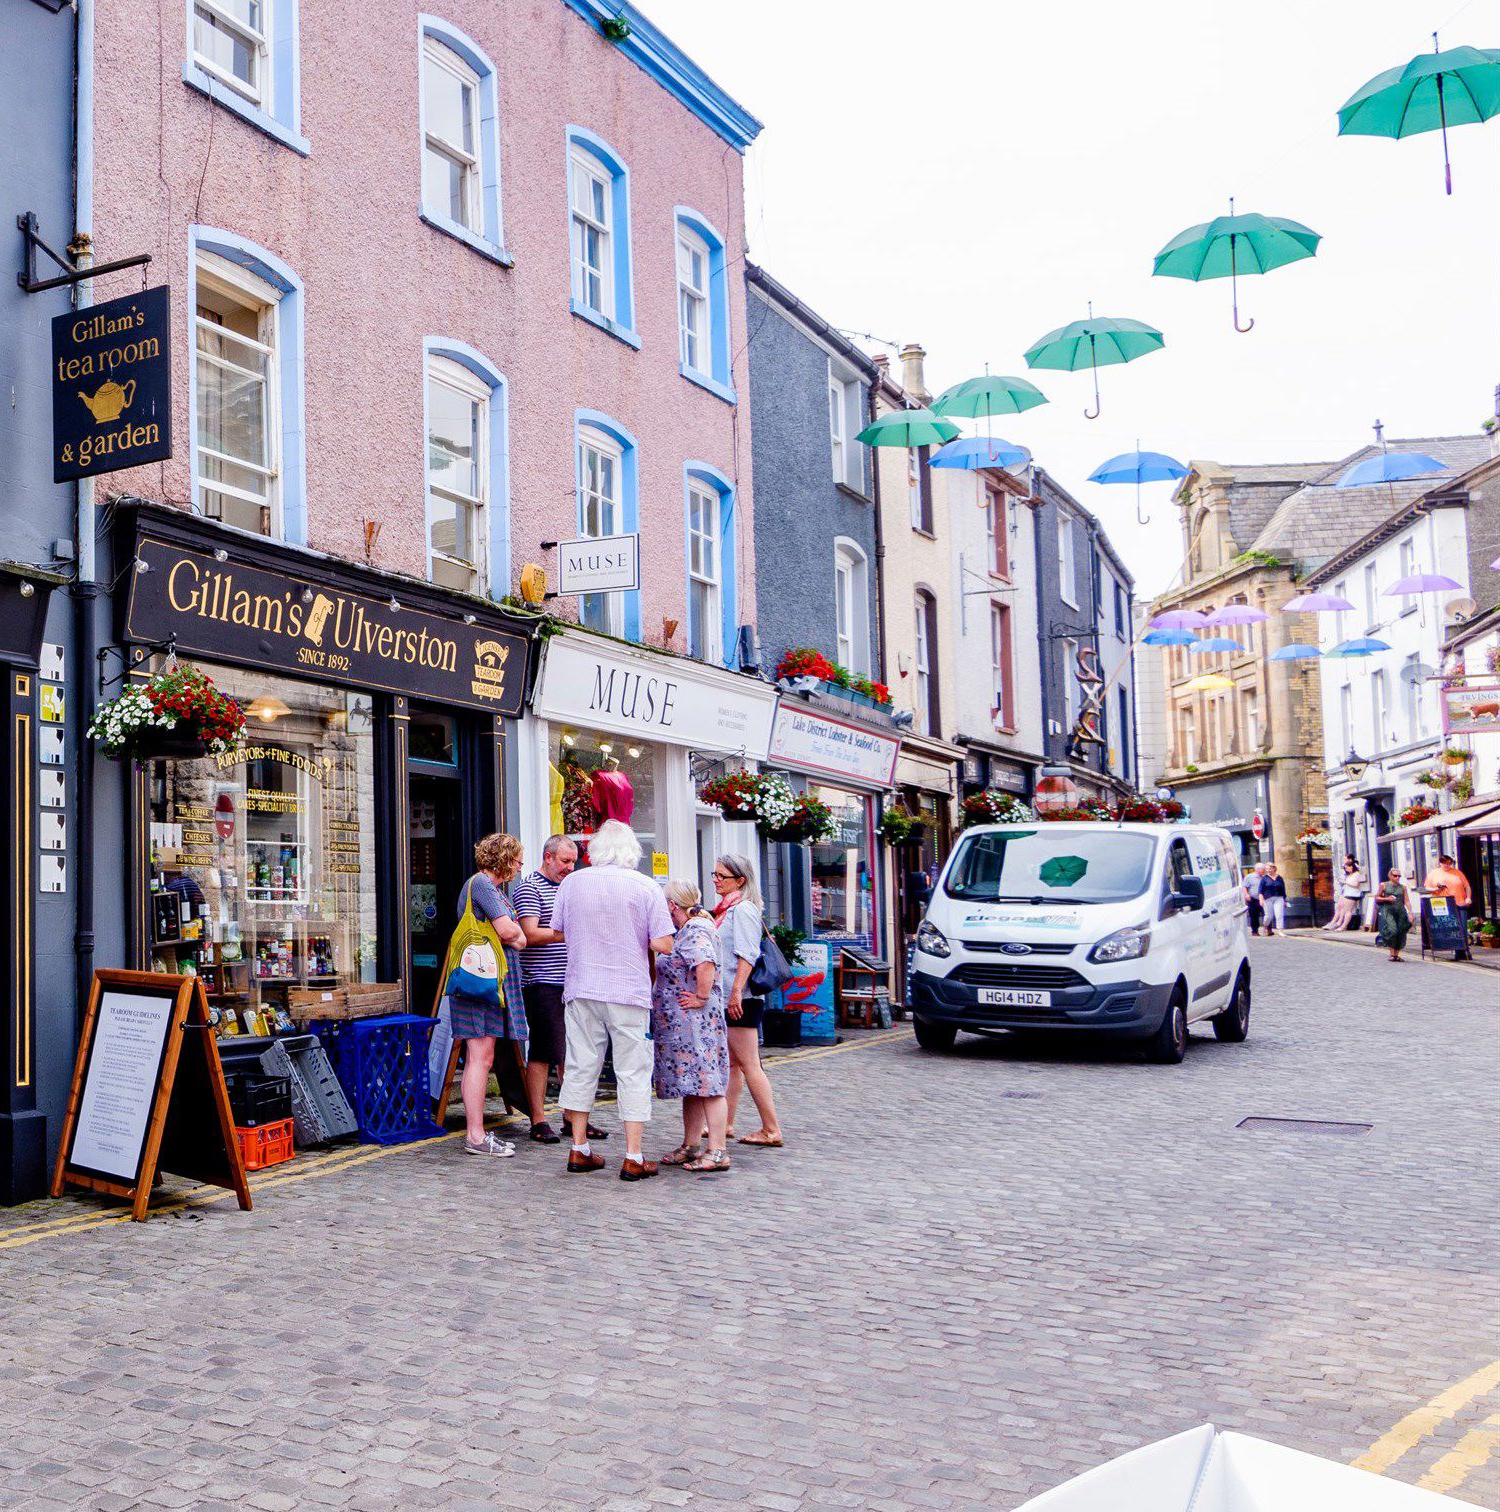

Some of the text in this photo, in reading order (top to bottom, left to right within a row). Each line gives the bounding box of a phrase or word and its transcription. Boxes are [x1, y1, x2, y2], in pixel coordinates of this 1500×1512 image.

[72, 306, 145, 343] Gillam's
[58, 337, 159, 382] tea room
[61, 423, 159, 467] & garden
[568, 553, 627, 572] MUSE
[168, 559, 303, 638] Gillam's
[334, 598, 458, 672] Ulverston
[298, 648, 349, 671] SINCE 1892
[589, 665, 677, 726] MUSE
[792, 716, 805, 731] Lake
[807, 720, 827, 737] District
[217, 747, 265, 770] PURVEYORS
[271, 748, 290, 764] FINE
[291, 754, 322, 780] FOODS
[110, 1007, 132, 1016] TEAROOM
[986, 991, 1043, 1004] HG14 HDZ
